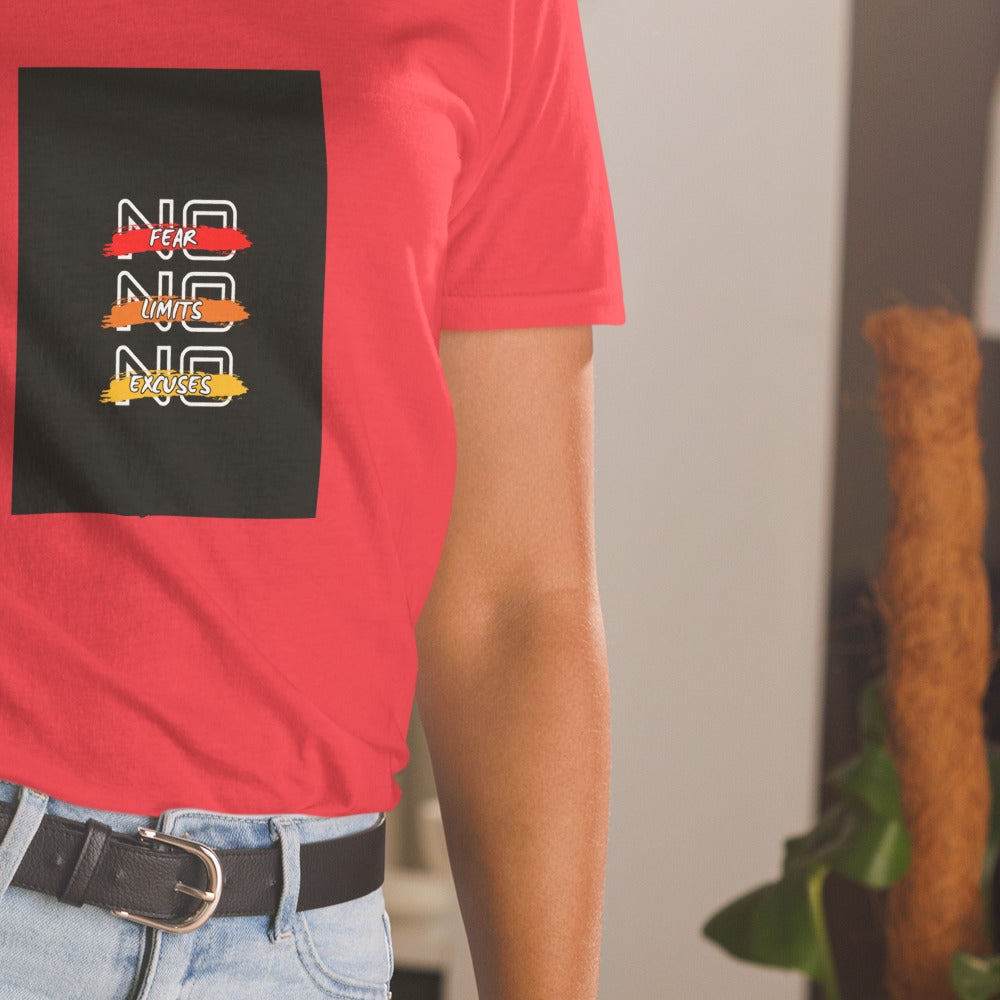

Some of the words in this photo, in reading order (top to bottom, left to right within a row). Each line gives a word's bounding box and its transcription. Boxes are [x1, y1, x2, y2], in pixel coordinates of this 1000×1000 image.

[118, 198, 238, 261] NO
[149, 227, 198, 248] FEAR
[116, 270, 236, 332] NO
[141, 298, 203, 321] LIMITS
[115, 345, 233, 407] NO
[129, 374, 212, 395] EXCUSES
